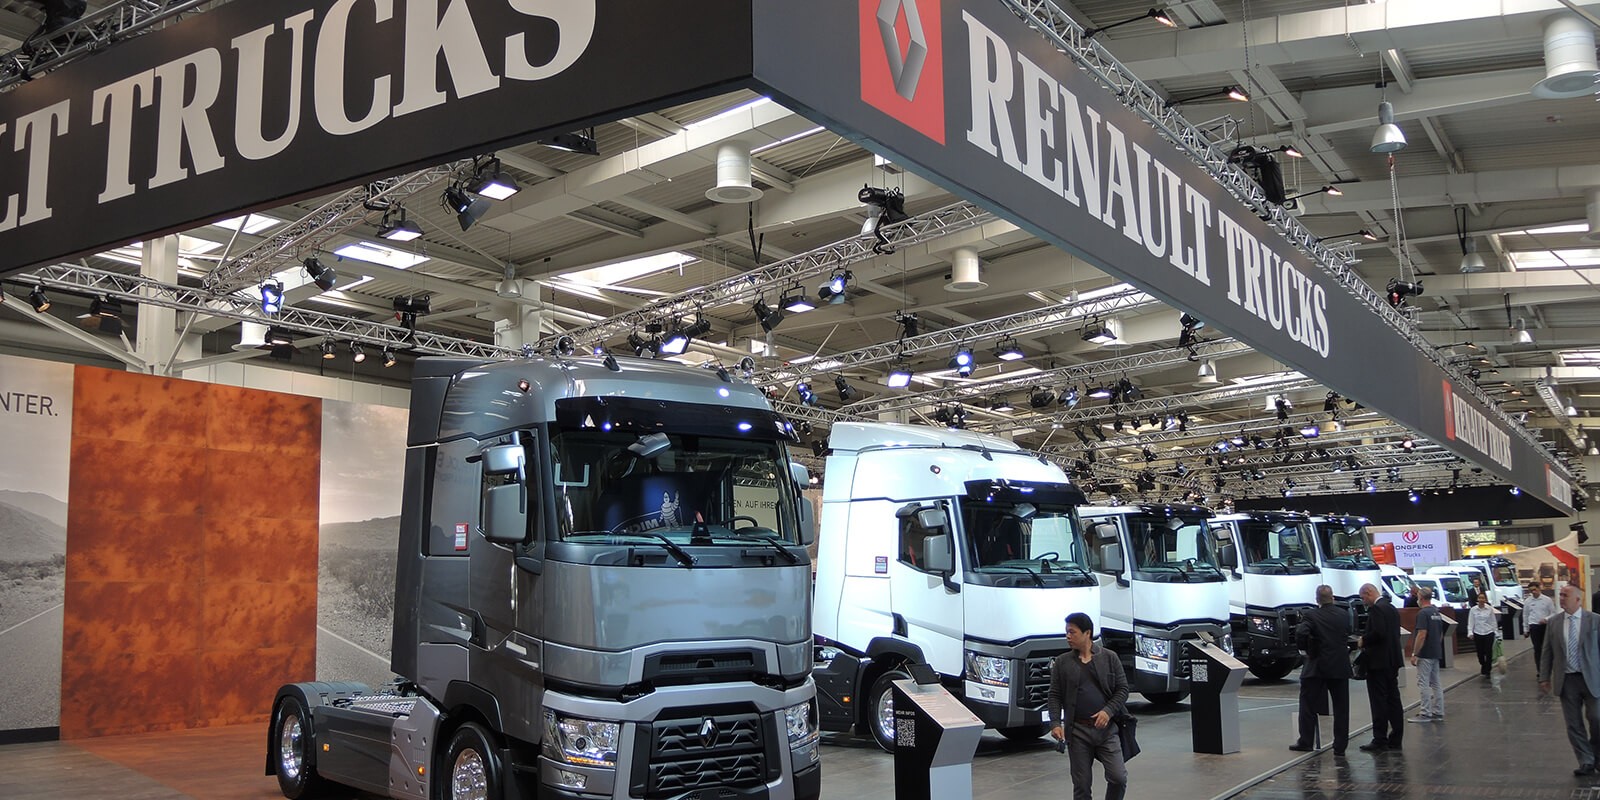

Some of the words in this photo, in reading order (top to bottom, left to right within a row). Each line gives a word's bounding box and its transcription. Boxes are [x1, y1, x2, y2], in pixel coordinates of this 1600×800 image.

[91, 0, 597, 204] TRUCKS
[962, 9, 1212, 286] RENAULT
[1217, 210, 1329, 358] TRUCKS
[1452, 392, 1488, 455] RENAULT
[760, 501, 777, 509] IHRE
[1395, 543, 1434, 551] ONGFENG
